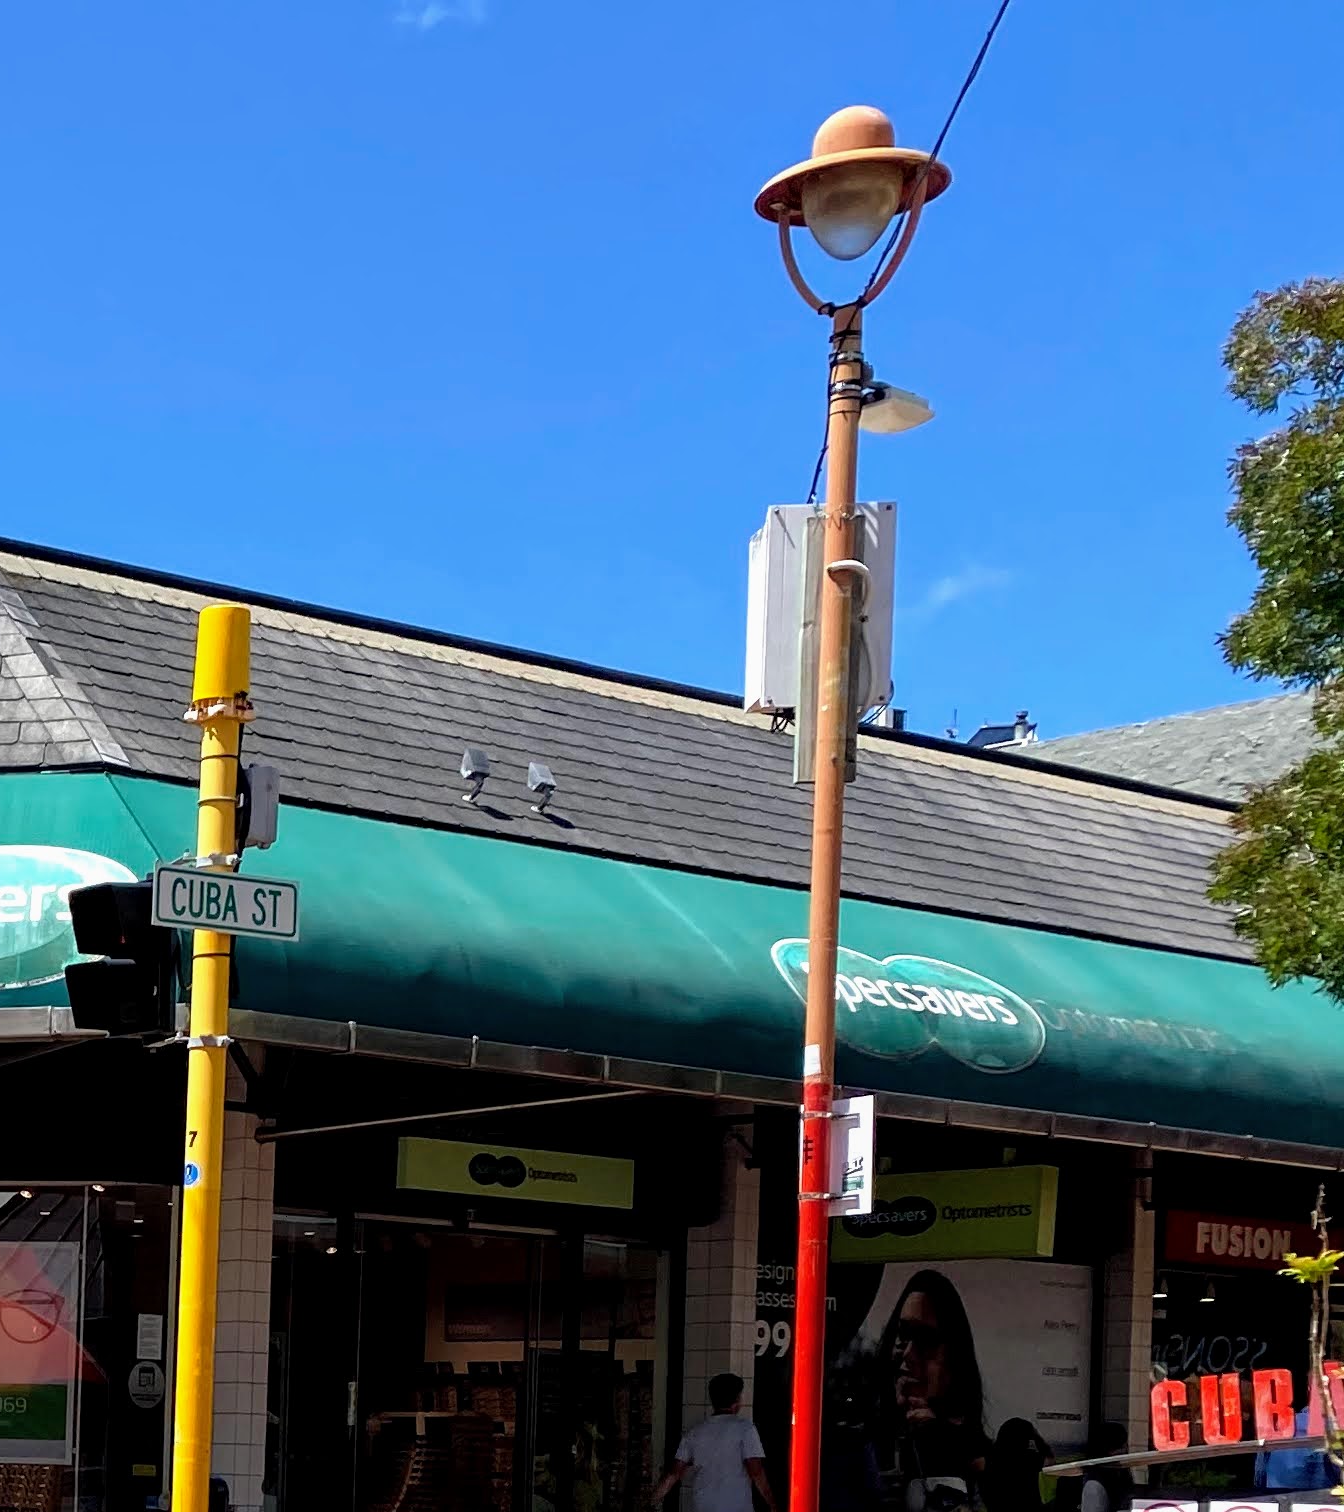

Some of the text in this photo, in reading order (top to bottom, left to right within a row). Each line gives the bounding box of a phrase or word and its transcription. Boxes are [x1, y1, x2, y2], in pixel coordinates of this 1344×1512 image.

[171, 877, 282, 928] CUBA ST
[801, 963, 1019, 1026] pecsavers
[188, 1130, 198, 1148] 7
[942, 1203, 1032, 1222] Optometrists
[1196, 1221, 1291, 1260] FUSION
